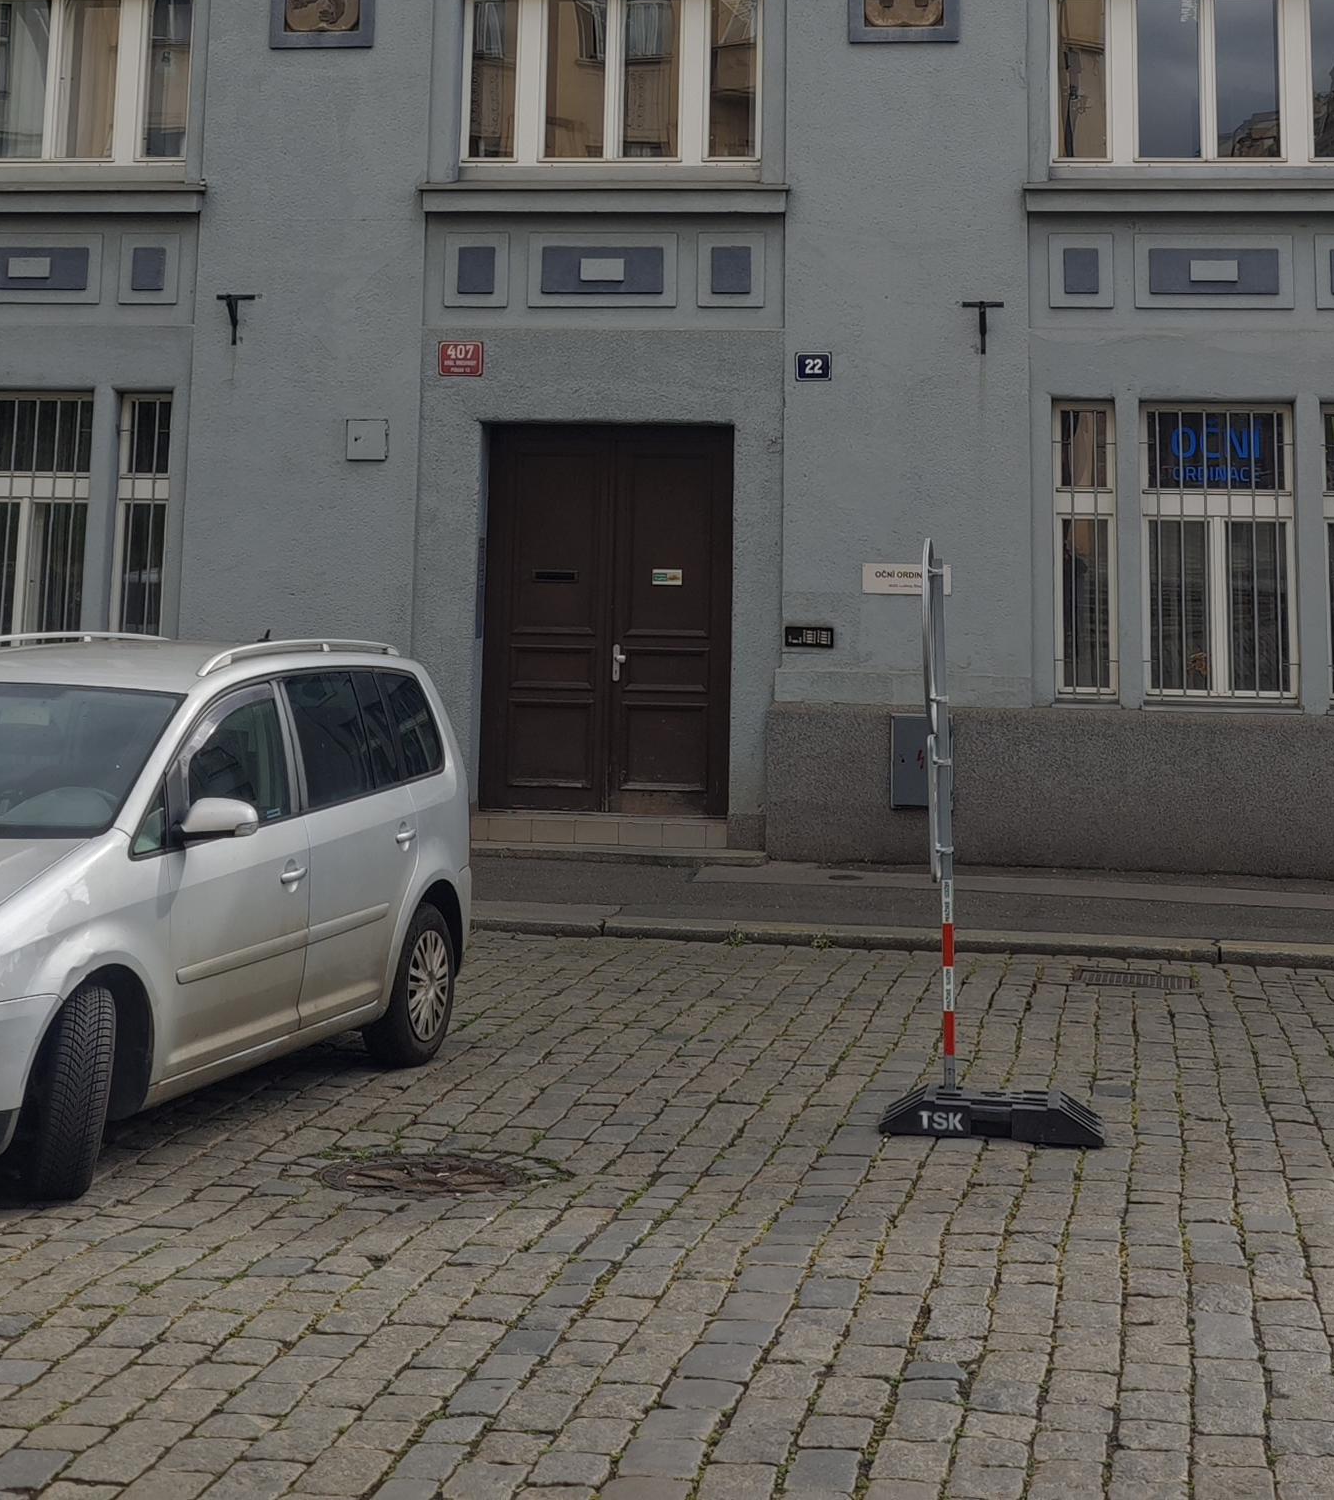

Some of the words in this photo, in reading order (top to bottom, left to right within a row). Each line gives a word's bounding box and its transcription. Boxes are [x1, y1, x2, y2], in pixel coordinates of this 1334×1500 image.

[447, 344, 474, 359] 407
[805, 358, 822, 374] 22
[1171, 418, 1262, 460] OČNÍ
[1172, 465, 1262, 483] ORDINACE
[875, 569, 895, 579] OČNÍ
[896, 570, 924, 580] ORDIN
[918, 1110, 964, 1132] TSK
